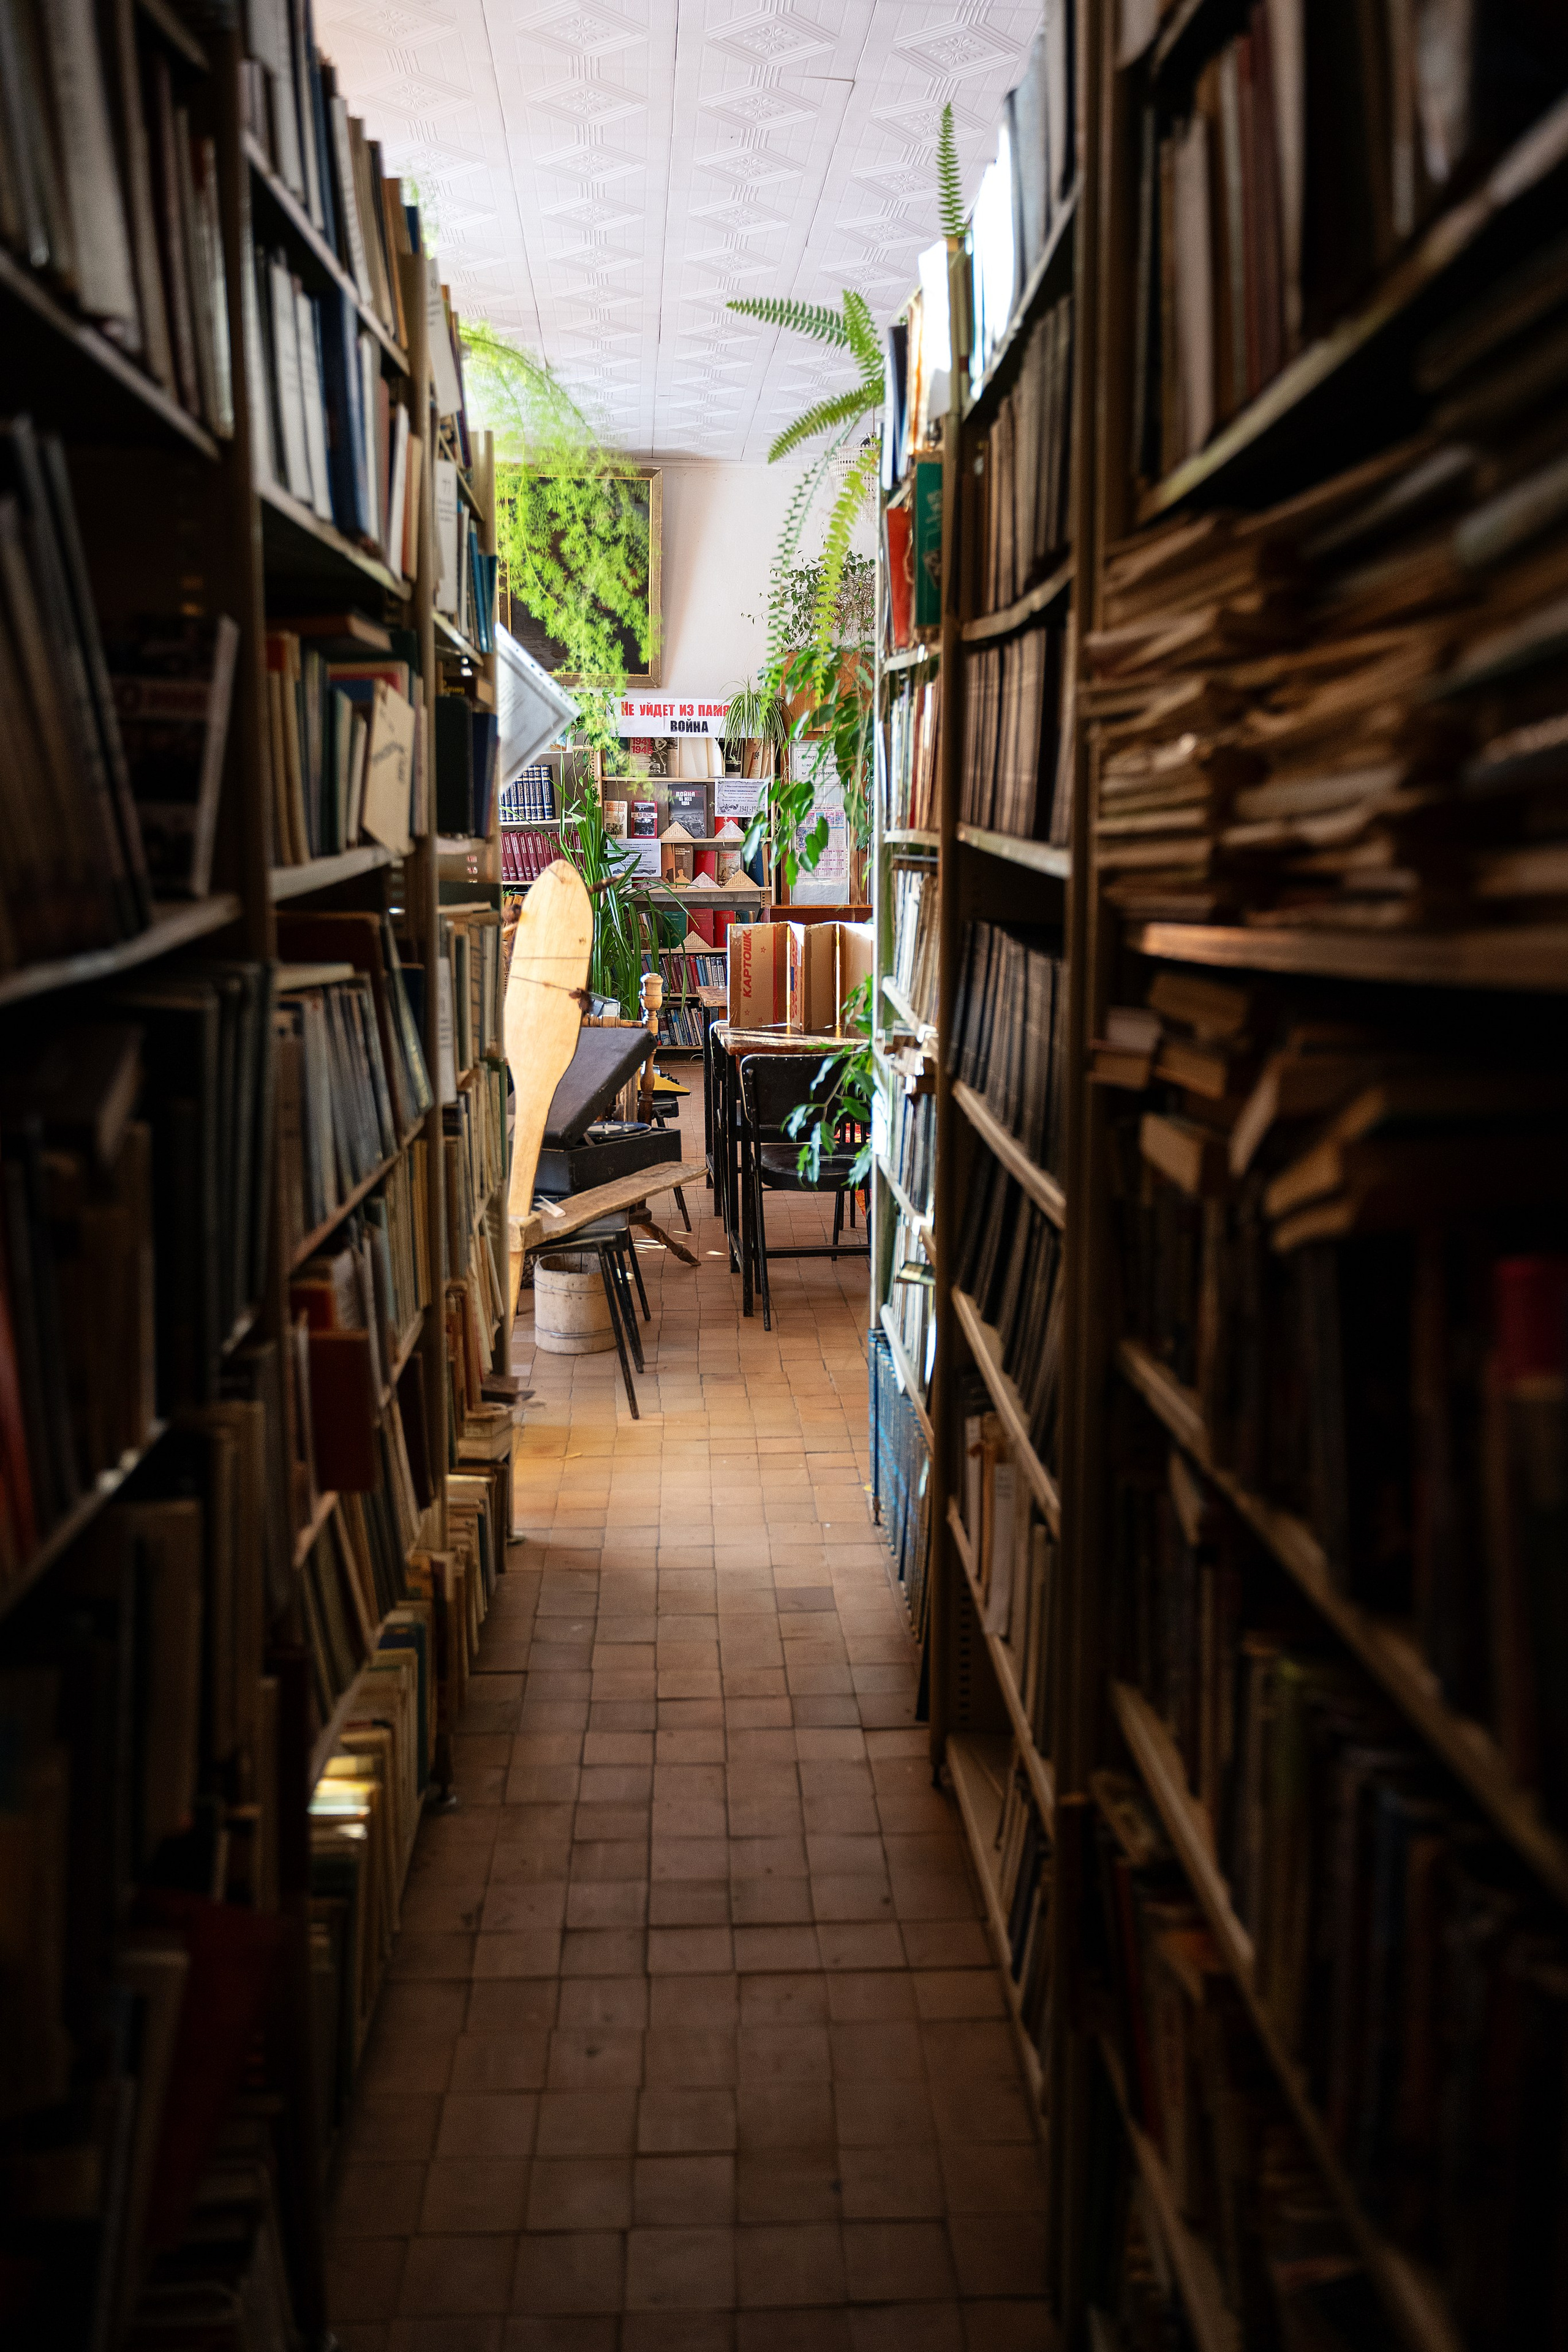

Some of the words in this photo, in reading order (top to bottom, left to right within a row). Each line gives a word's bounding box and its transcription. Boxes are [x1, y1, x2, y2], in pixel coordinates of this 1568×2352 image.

[621, 701, 635, 716] НЕ
[639, 702, 675, 717] УЙДЕТ
[679, 704, 694, 716] ИЗ
[698, 704, 730, 717] ПАМЯ
[670, 718, 709, 733] ВОЙНА
[631, 745, 653, 754] 1945
[743, 929, 752, 998] КАРТОШК
